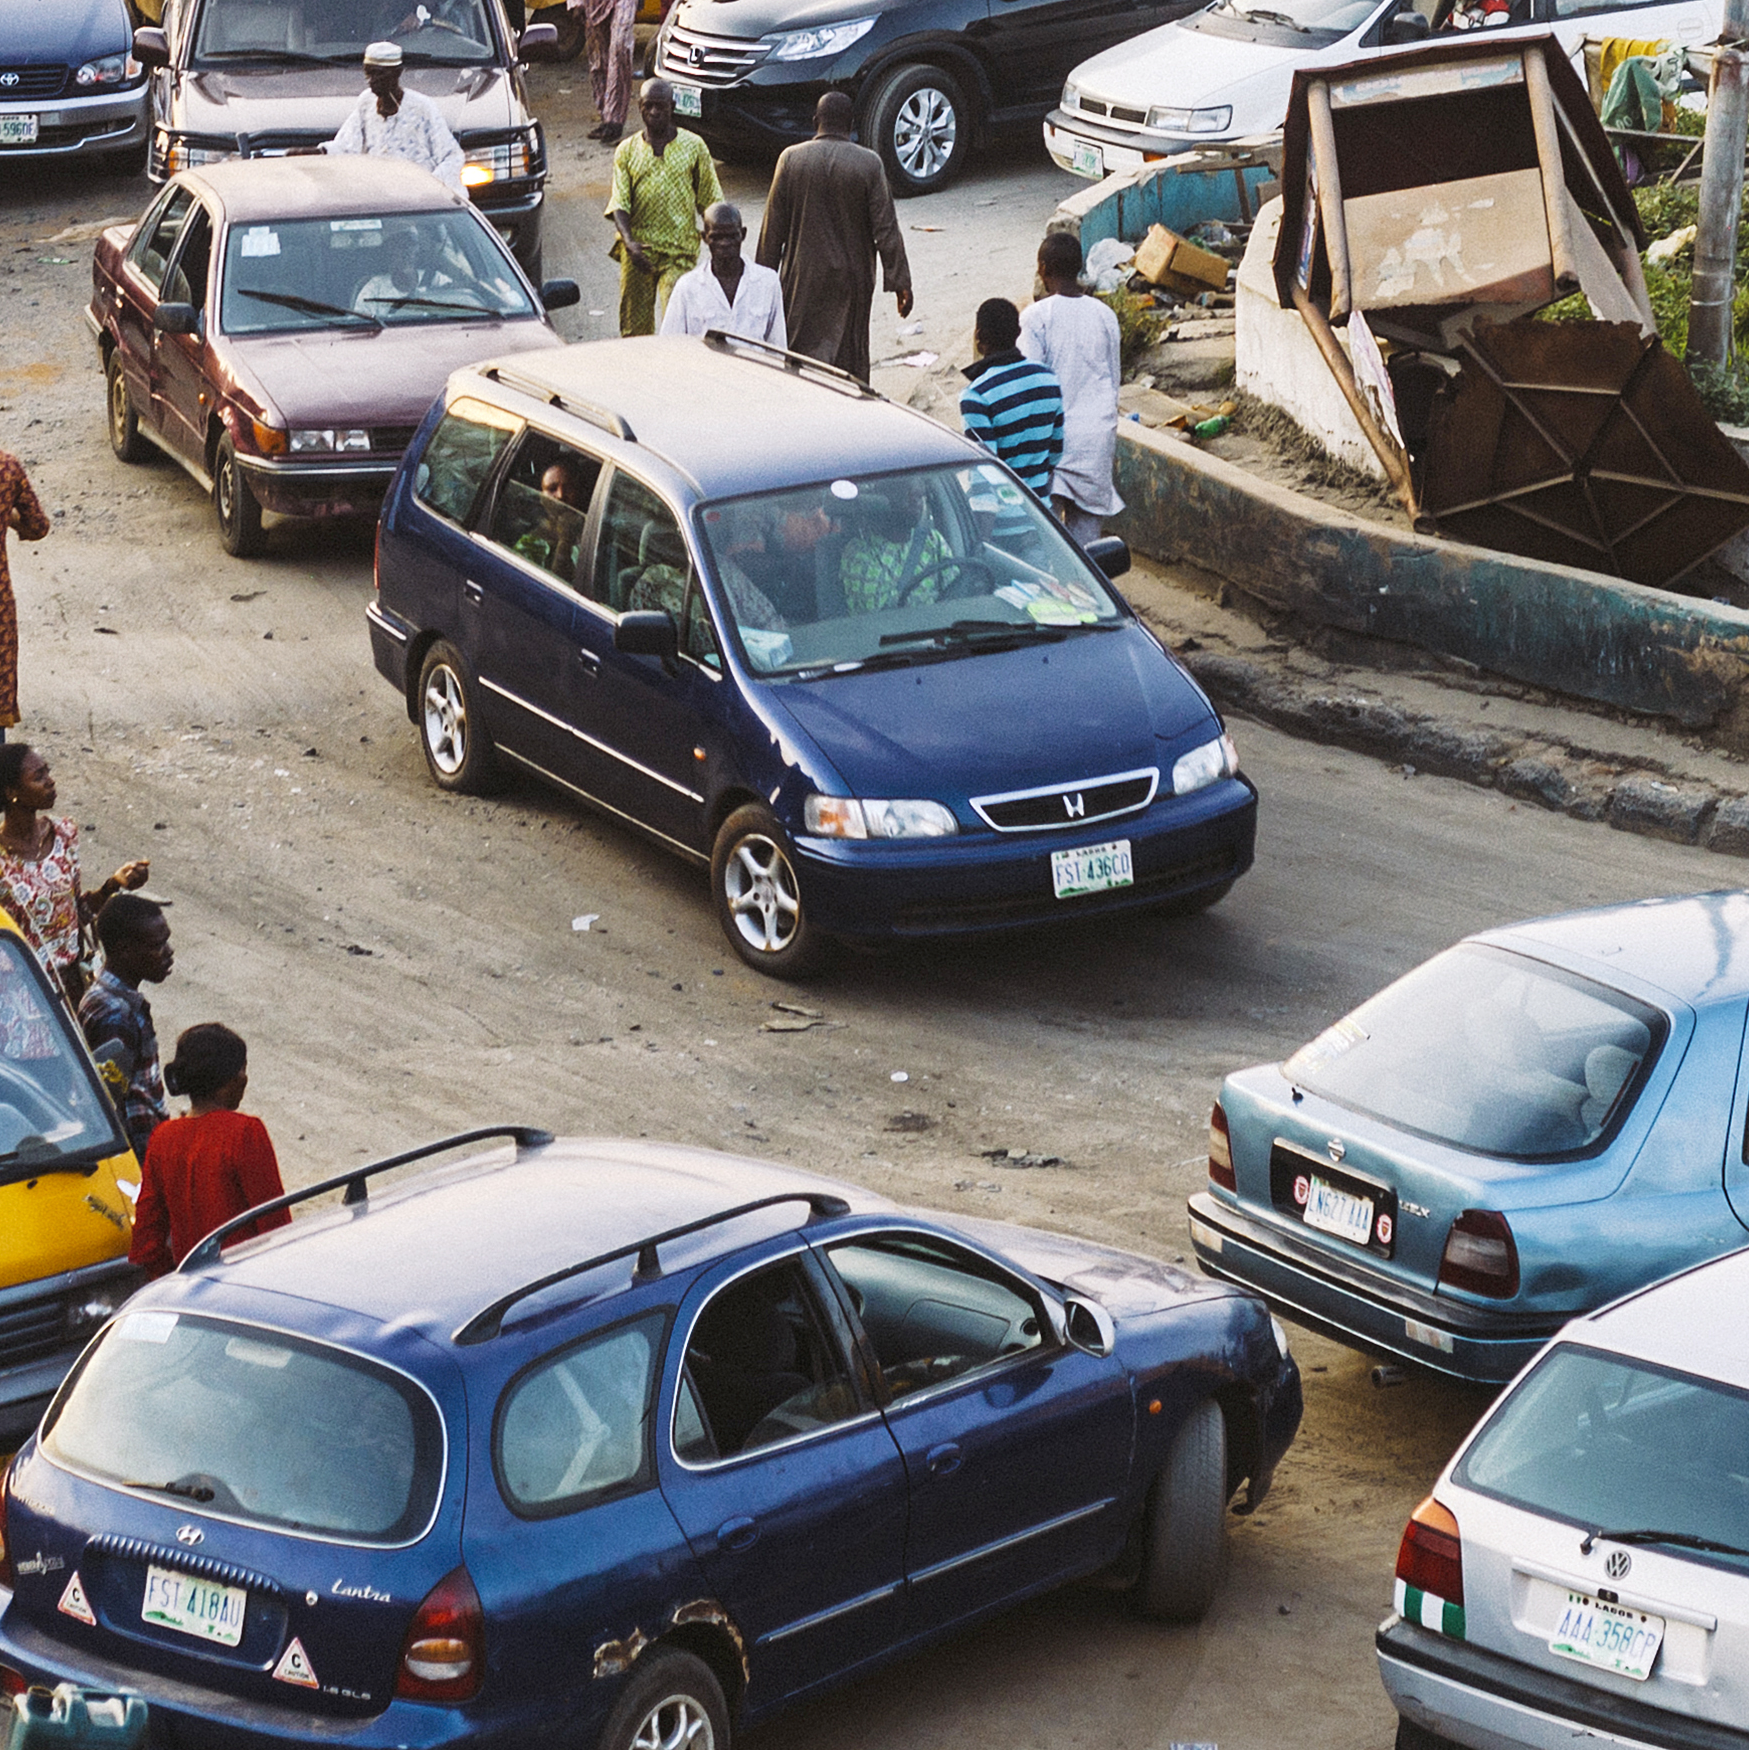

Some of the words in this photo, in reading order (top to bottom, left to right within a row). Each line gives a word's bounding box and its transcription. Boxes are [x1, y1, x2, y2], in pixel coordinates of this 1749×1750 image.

[72, 1587, 82, 1604] C
[330, 1577, 393, 1604] Lantra
[1558, 1608, 1656, 1659] AAA-358CP
[290, 1652, 303, 1669] C
